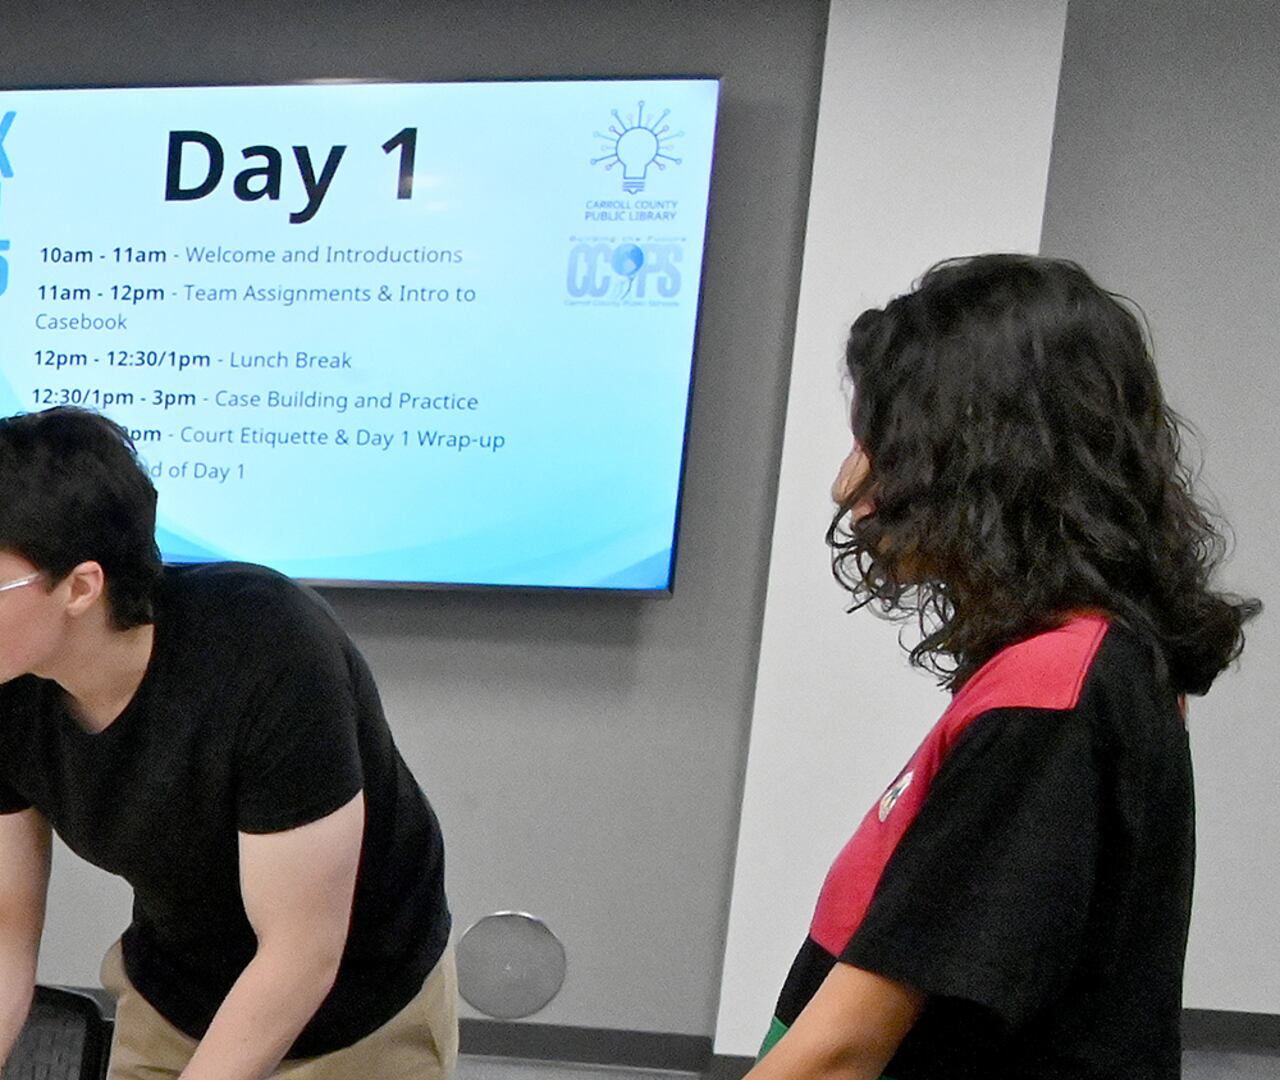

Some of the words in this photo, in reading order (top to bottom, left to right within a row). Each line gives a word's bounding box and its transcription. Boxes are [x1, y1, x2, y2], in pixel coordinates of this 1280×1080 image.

[165, 130, 347, 224] Day
[382, 127, 417, 199] 1
[586, 200, 630, 209] CARROLL
[635, 200, 677, 209] COUNTY
[585, 211, 625, 221] PUBLIC
[629, 211, 676, 220] LIBRARY
[41, 247, 92, 263] 10am
[114, 247, 166, 262] 11am
[186, 247, 275, 262] Welcome
[282, 246, 319, 262] and
[327, 246, 461, 262] Introductions
[39, 285, 90, 300] 11am
[111, 285, 164, 304] 12pm
[184, 285, 236, 301] Team
[243, 286, 371, 306] Assignments
[378, 285, 392, 301] &
[400, 285, 448, 301] Intro
[457, 288, 475, 301] to
[36, 313, 126, 329] Casebook
[36, 350, 87, 370] 12pm
[108, 351, 210, 371] 12:30/1pm
[231, 352, 288, 367] Lunch
[296, 352, 351, 368] Break
[33, 389, 133, 409] 12:30/1pm
[153, 390, 195, 409] 3pm
[216, 390, 261, 407] Case
[268, 391, 347, 413] Building
[355, 392, 392, 408] and
[400, 393, 478, 410] Practice
[181, 427, 232, 443] Court
[241, 428, 328, 448] Etiquette
[335, 429, 348, 445] &
[357, 429, 394, 451] Day
[418, 431, 505, 452] Wrap-up
[169, 462, 187, 478] of
[194, 463, 230, 483] Day
